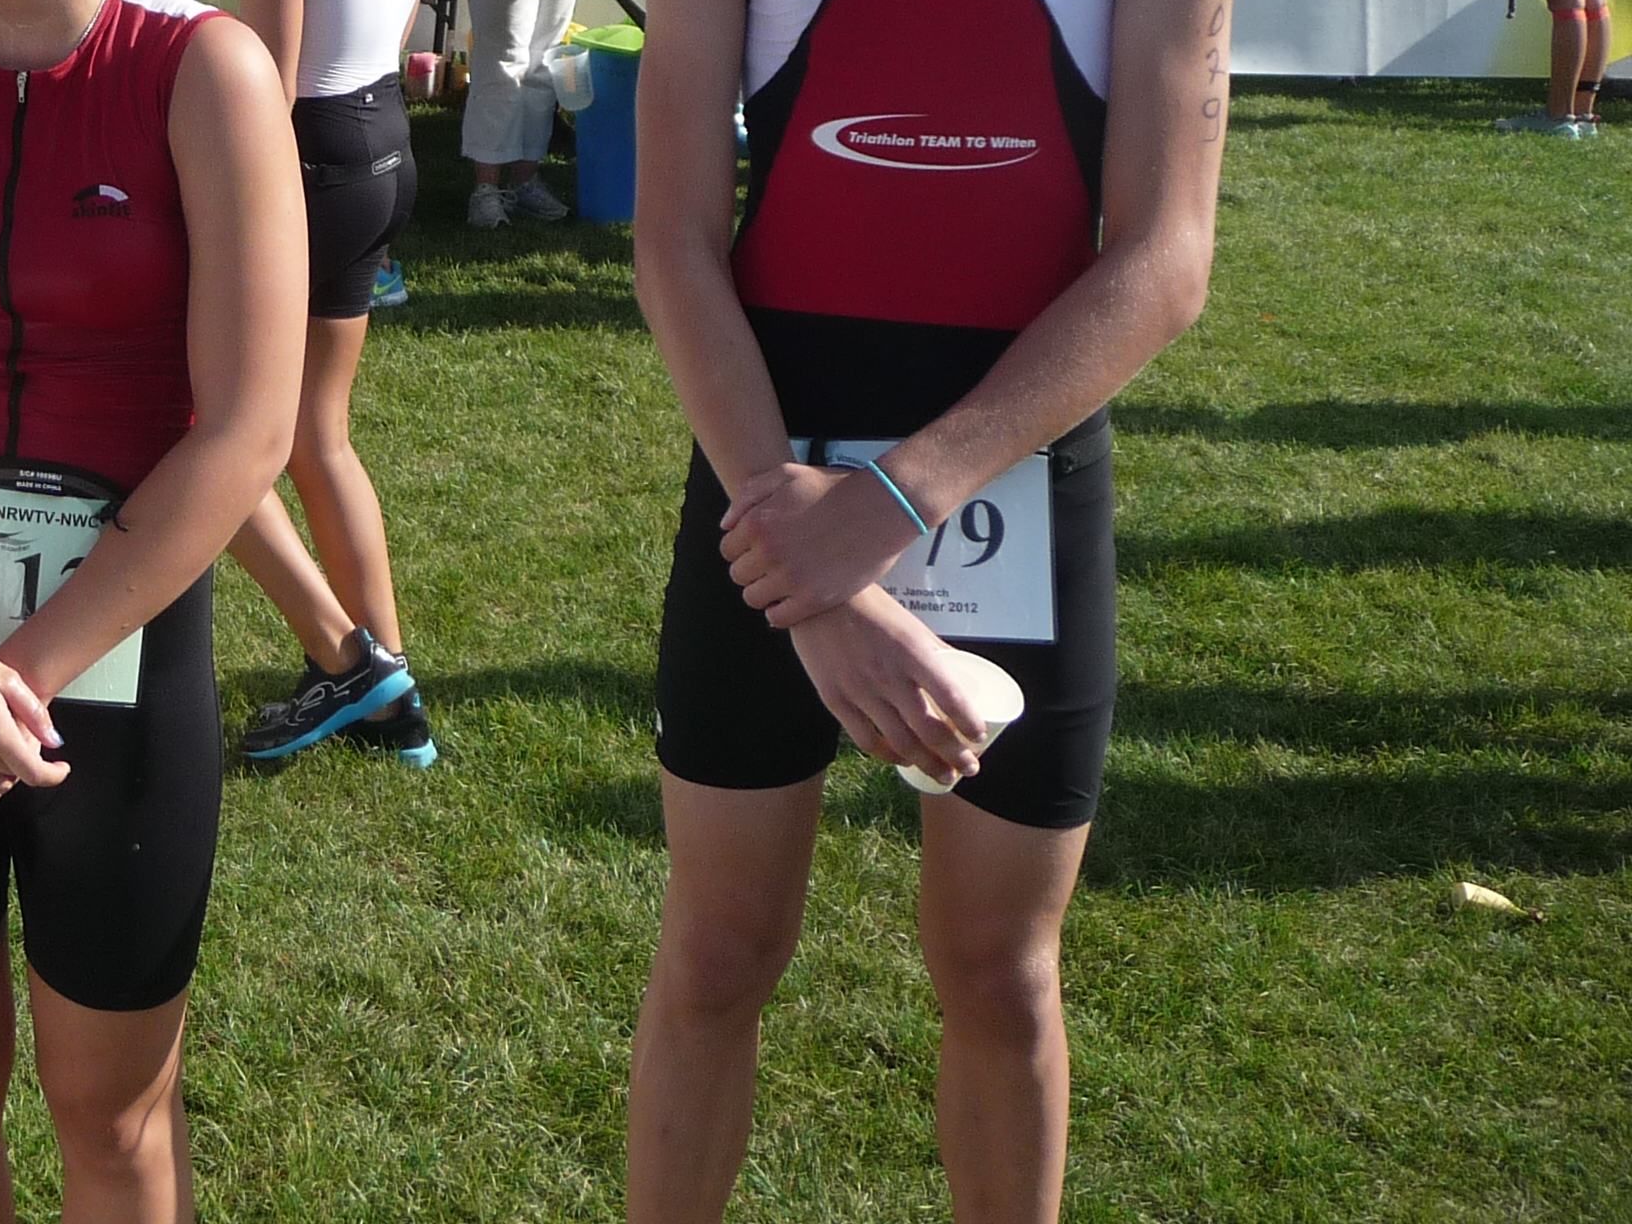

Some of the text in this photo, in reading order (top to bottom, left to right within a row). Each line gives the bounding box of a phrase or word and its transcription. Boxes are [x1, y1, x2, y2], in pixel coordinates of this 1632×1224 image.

[848, 131, 1036, 148] Triathlon TEAM TG Witten
[903, 587, 949, 598] Janosch
[909, 601, 945, 612] Meter
[948, 602, 979, 614] 2012
